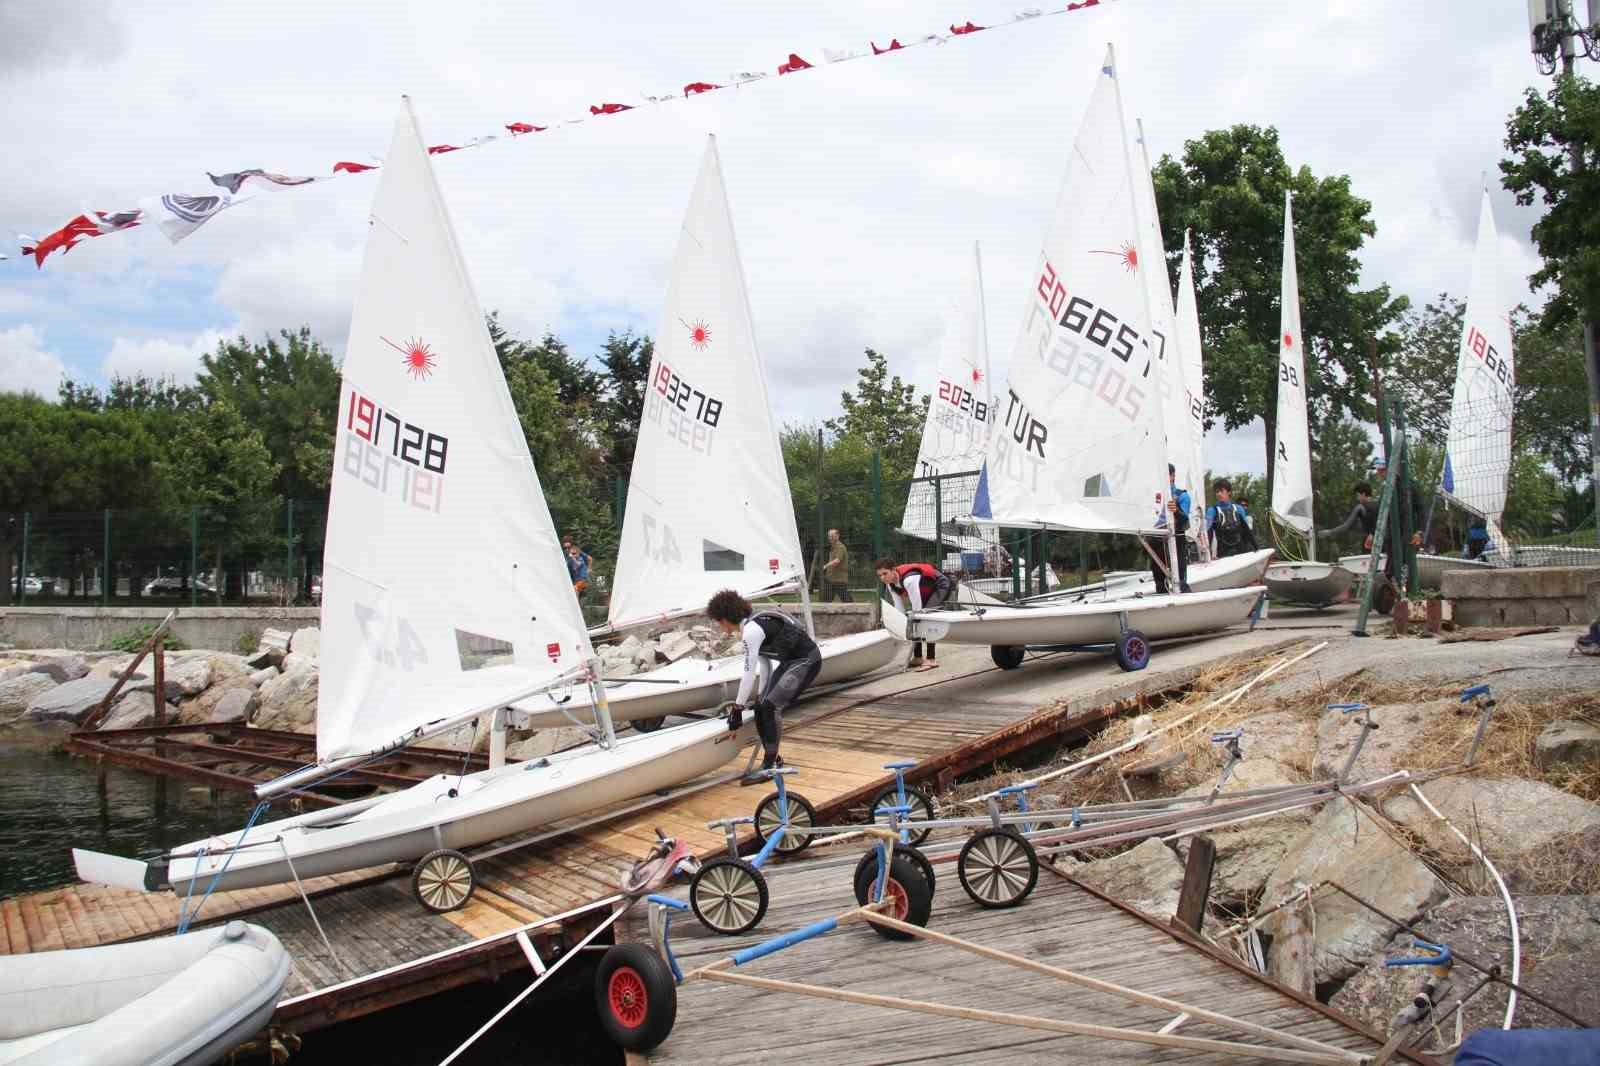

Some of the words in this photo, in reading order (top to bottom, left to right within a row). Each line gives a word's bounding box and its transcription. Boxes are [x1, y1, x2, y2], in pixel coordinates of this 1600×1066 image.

[653, 361, 723, 428] 193278
[1005, 389, 1048, 457] TUR
[348, 391, 449, 474] 191728
